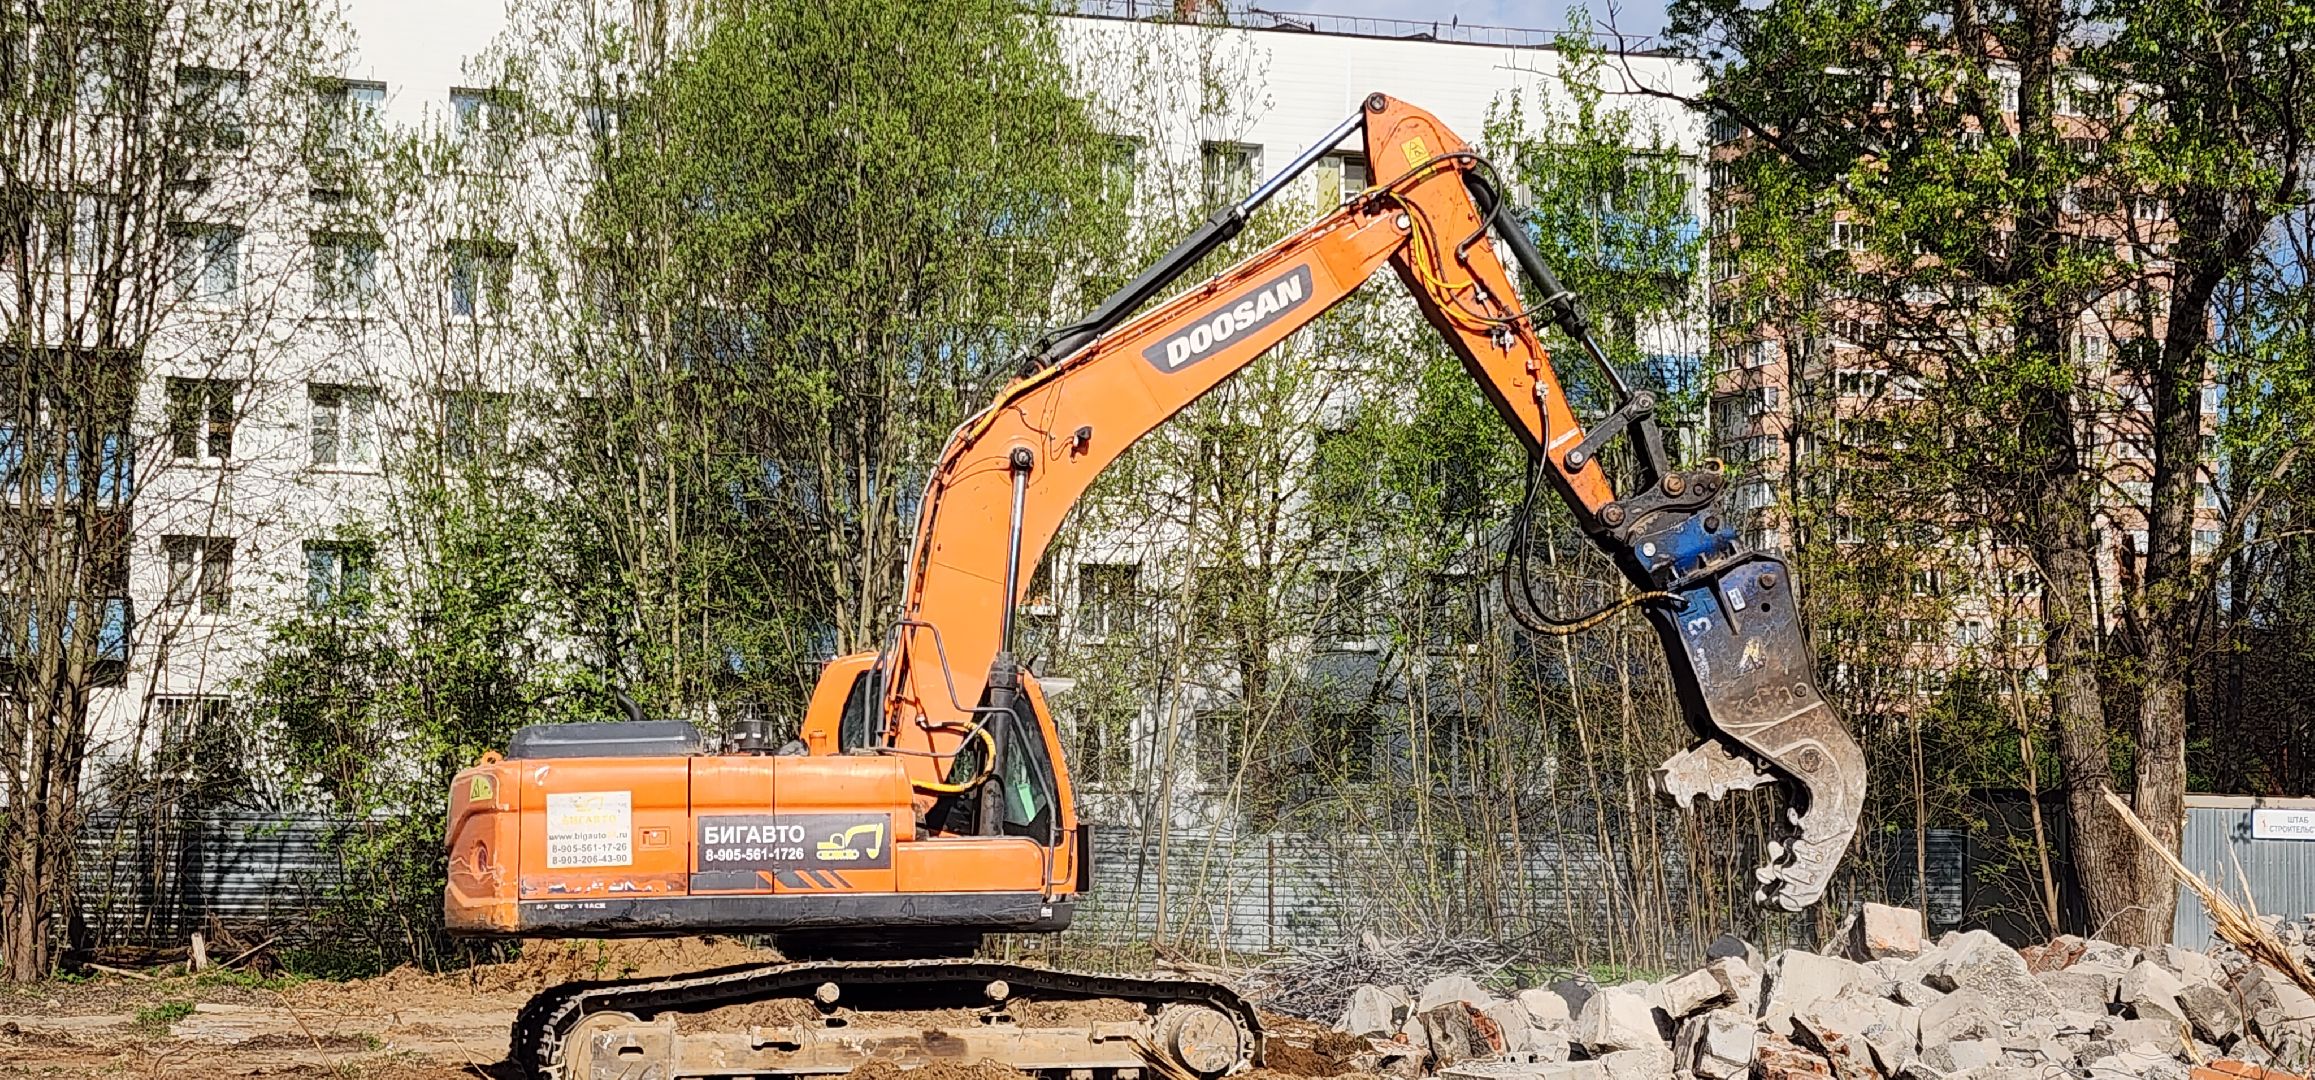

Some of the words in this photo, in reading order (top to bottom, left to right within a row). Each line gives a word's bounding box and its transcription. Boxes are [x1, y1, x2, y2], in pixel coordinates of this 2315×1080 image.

[1166, 274, 1302, 368] DOOSAN
[704, 825, 805, 845] БИГАВТО
[2269, 825, 2315, 834] СТРОИТЕЛЬС
[552, 843, 627, 853] 8-905-561-17-26
[705, 847, 804, 862] 8-905-561-1726
